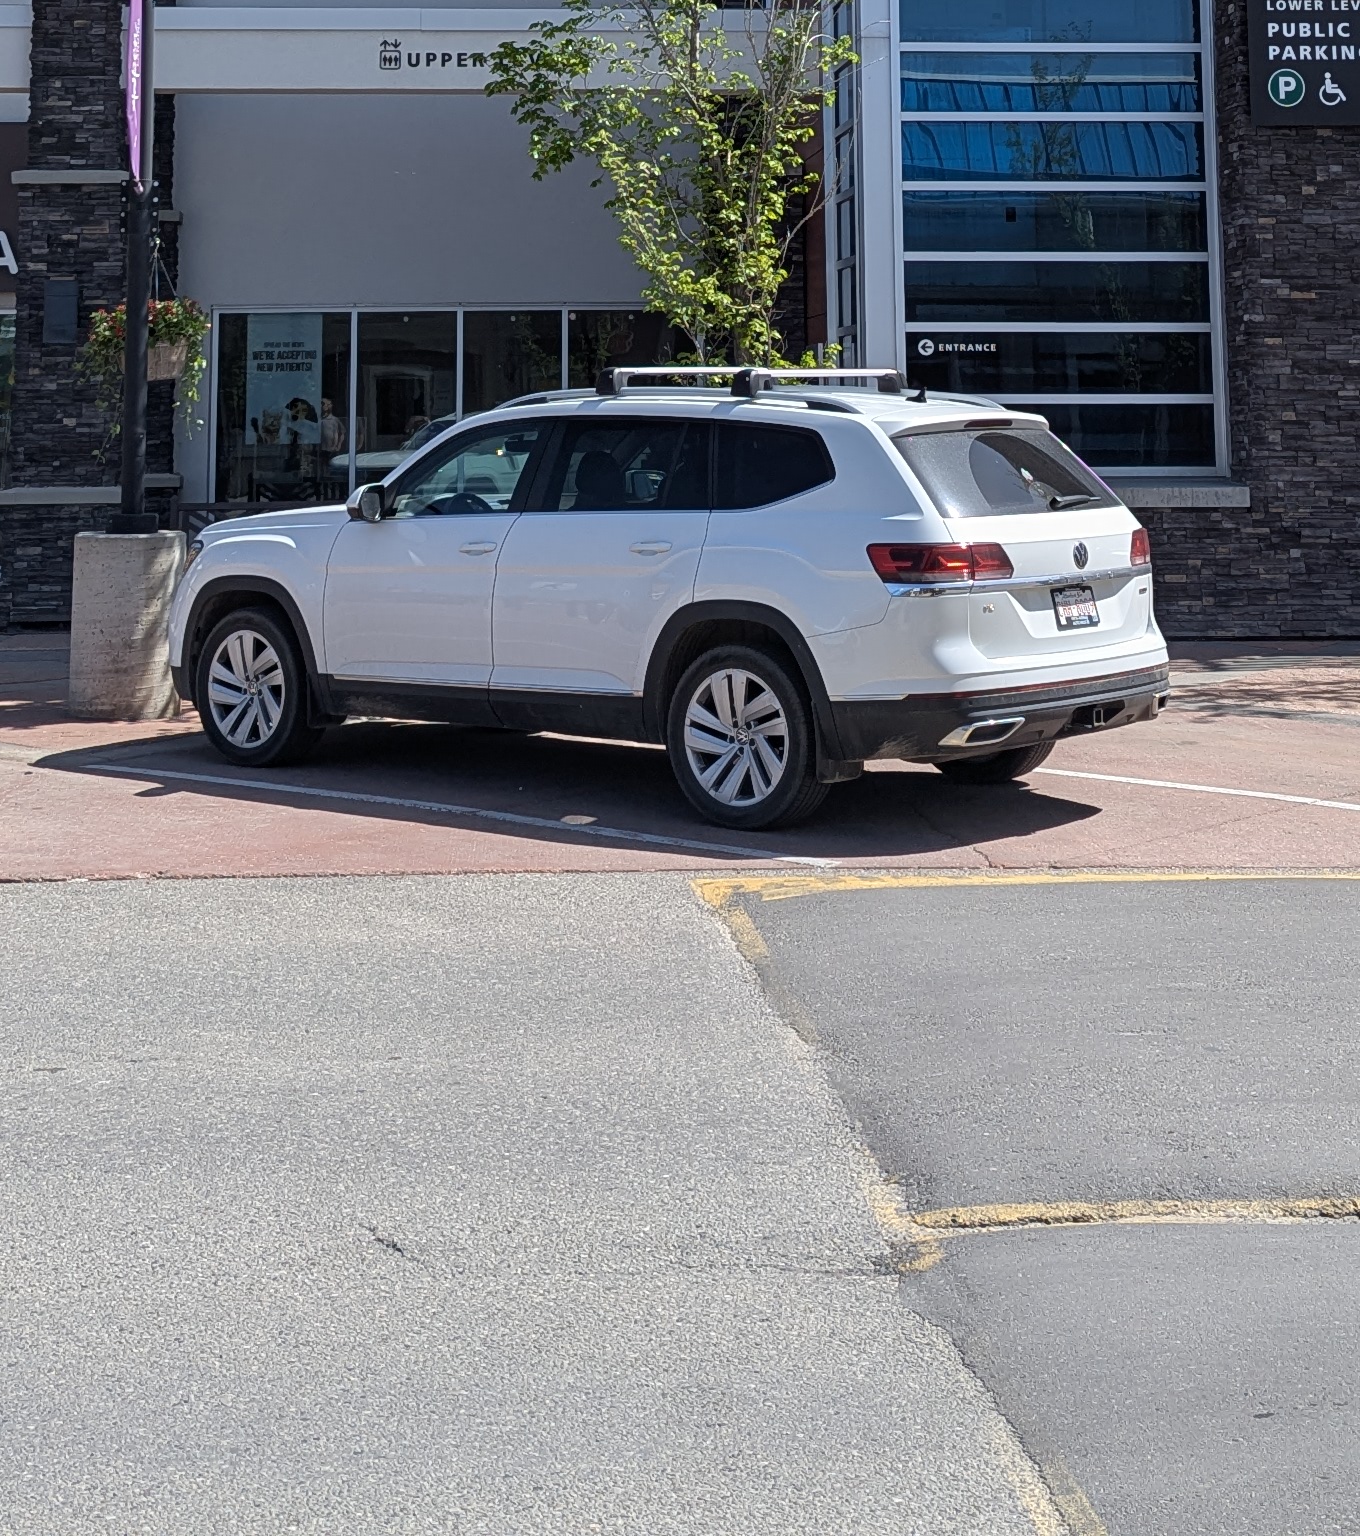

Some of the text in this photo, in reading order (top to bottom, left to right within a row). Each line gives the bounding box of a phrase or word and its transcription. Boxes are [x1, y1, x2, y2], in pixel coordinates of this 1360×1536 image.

[1266, 0, 1324, 11] LOWER
[1267, 22, 1351, 38] PUBLIC
[938, 343, 997, 352] ENTRANCE
